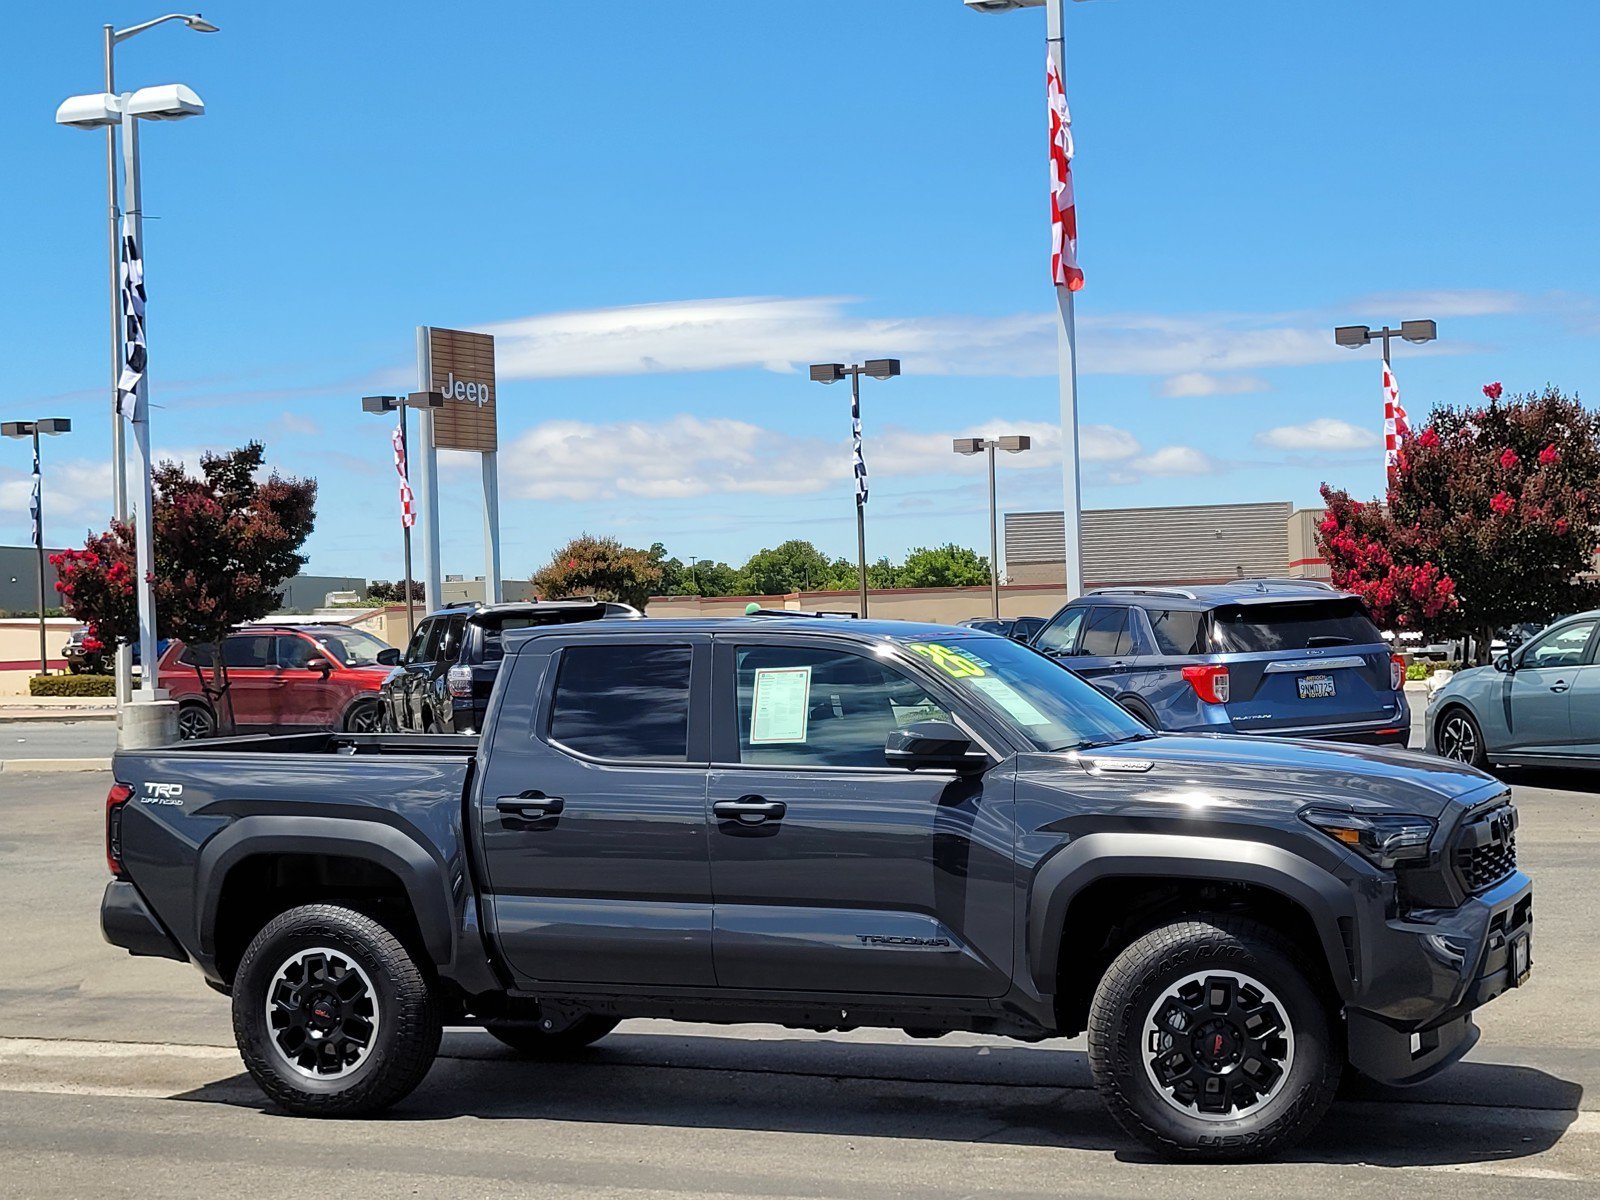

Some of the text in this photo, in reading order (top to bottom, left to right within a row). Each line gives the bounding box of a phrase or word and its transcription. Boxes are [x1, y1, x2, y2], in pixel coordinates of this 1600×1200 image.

[441, 372, 489, 408] Jeep
[909, 643, 986, 678] 26
[1300, 682, 1334, 695] 9NMD725
[144, 782, 183, 798] TRD
[855, 933, 950, 947] TACOMA
